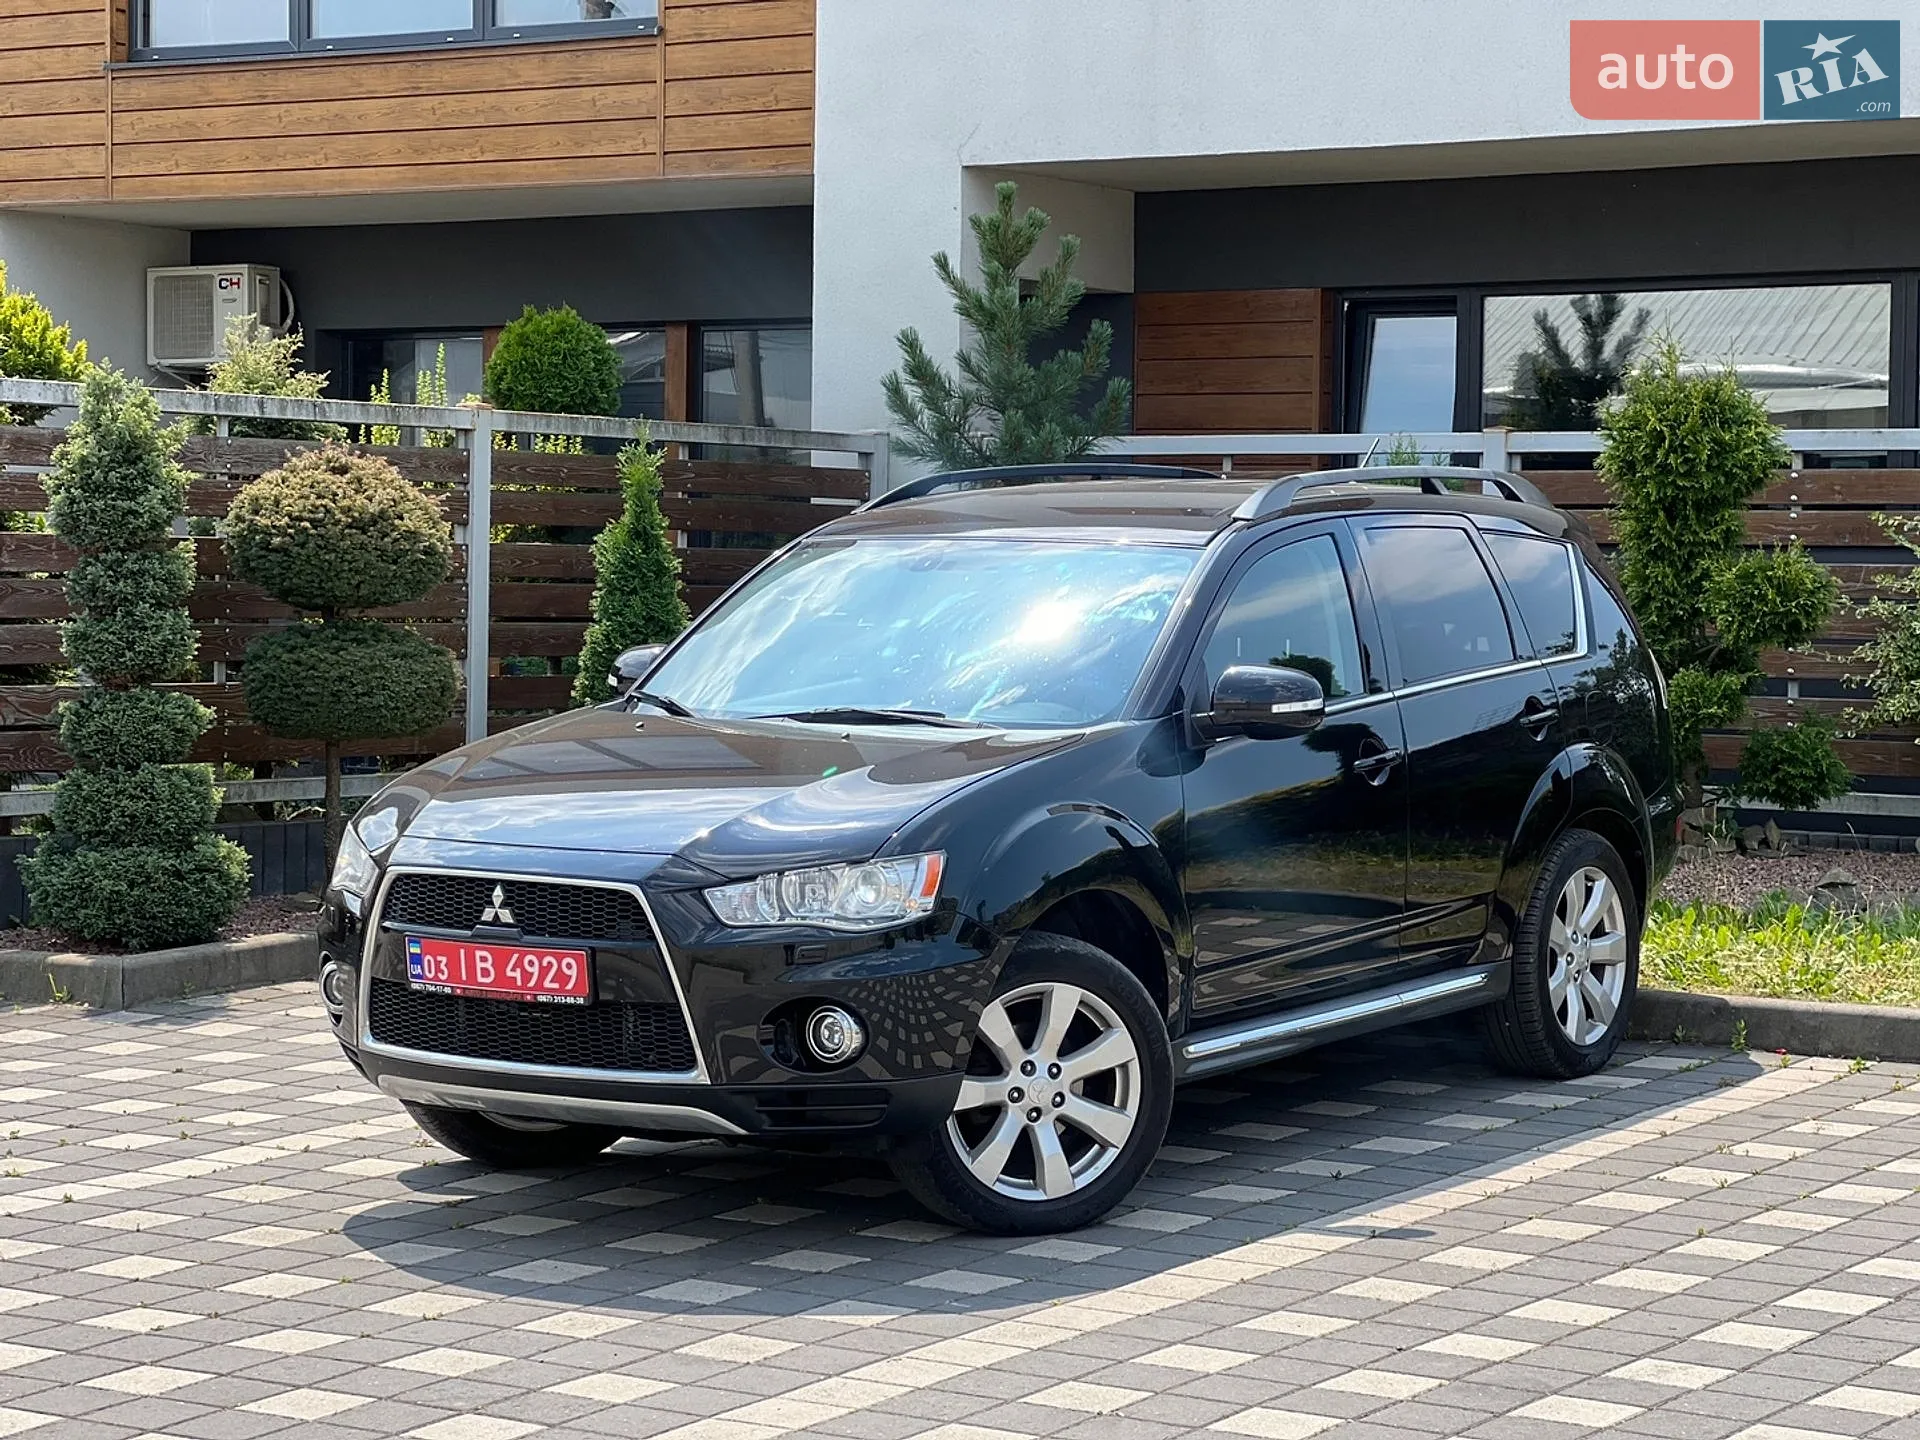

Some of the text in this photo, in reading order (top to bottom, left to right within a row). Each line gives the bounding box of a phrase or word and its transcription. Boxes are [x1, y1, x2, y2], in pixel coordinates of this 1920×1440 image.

[218, 277, 241, 290] CH
[410, 964, 423, 976] UA
[424, 954, 449, 980] 03
[505, 952, 578, 991] 4929
